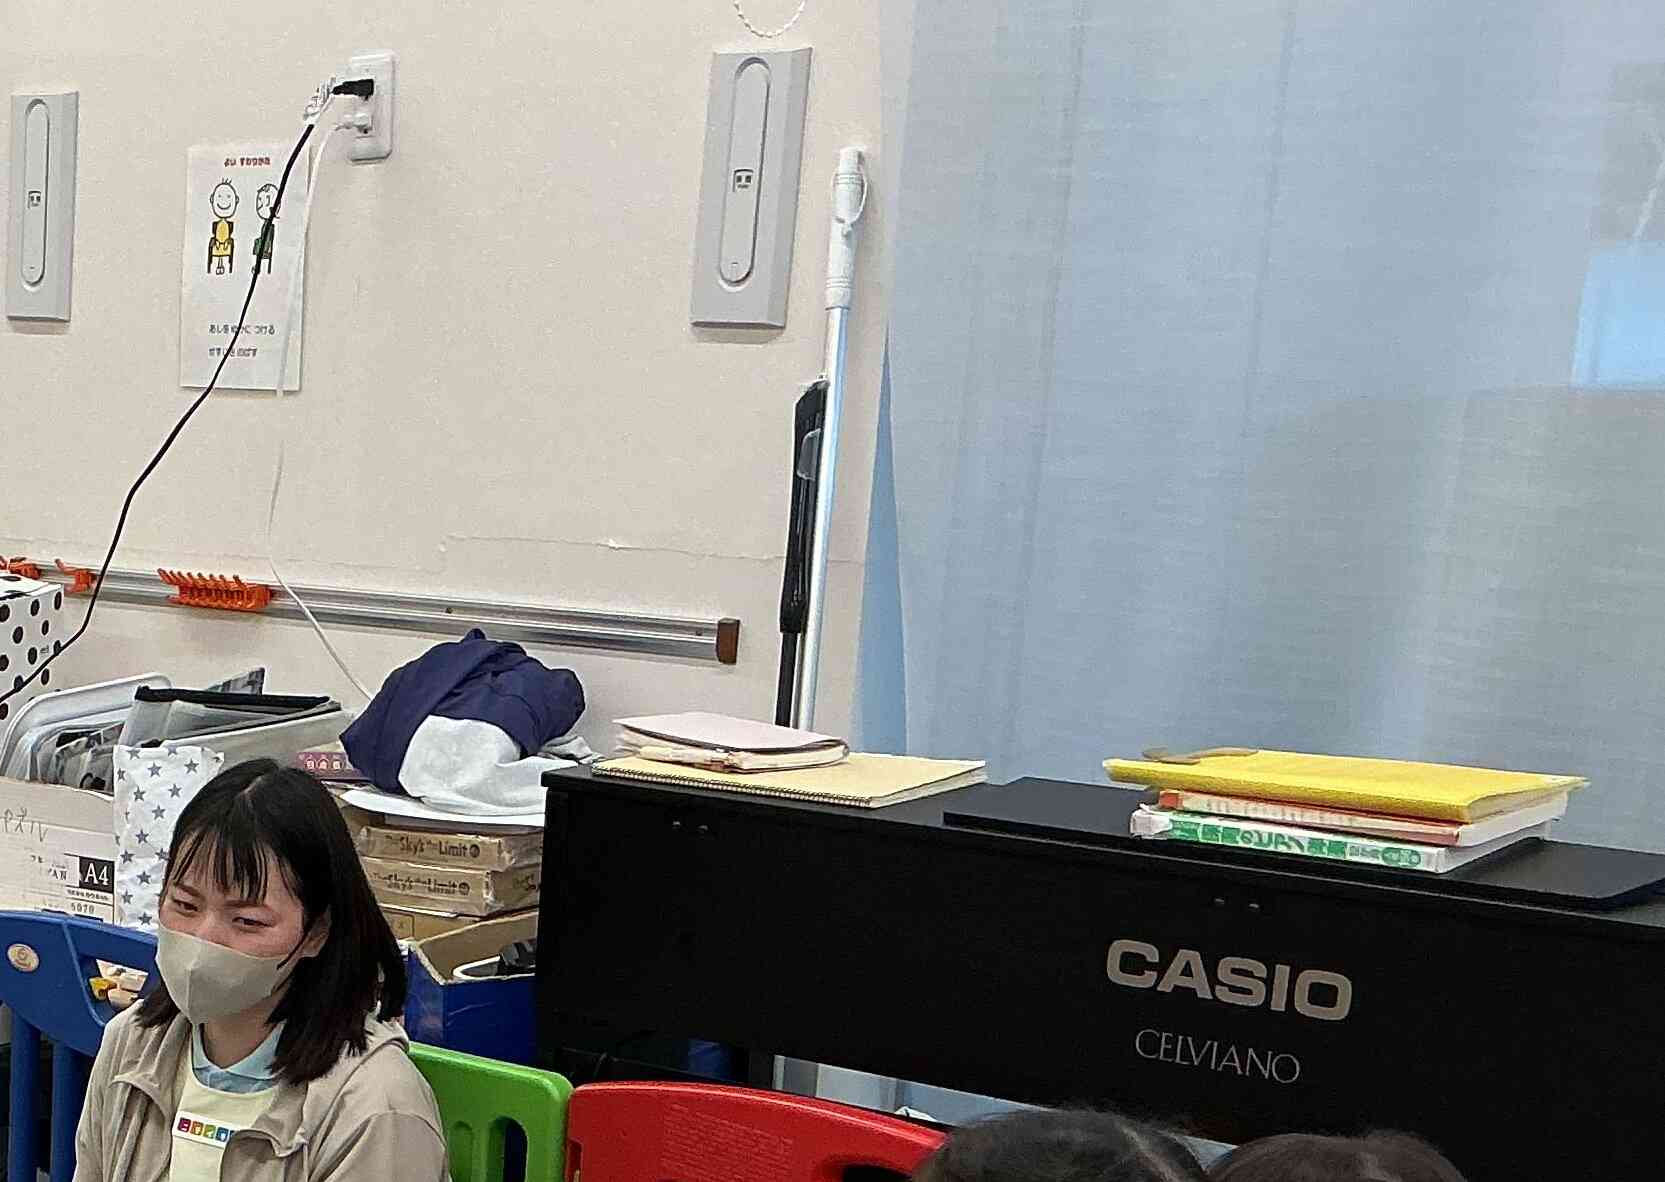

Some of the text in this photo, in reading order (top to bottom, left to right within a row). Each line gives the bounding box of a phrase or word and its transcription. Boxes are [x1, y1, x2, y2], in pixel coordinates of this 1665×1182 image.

[439, 840, 468, 859] Limit
[85, 862, 110, 886] A4
[1106, 939, 1352, 1021] CASIO
[1135, 1028, 1301, 1084] CELVIANO
